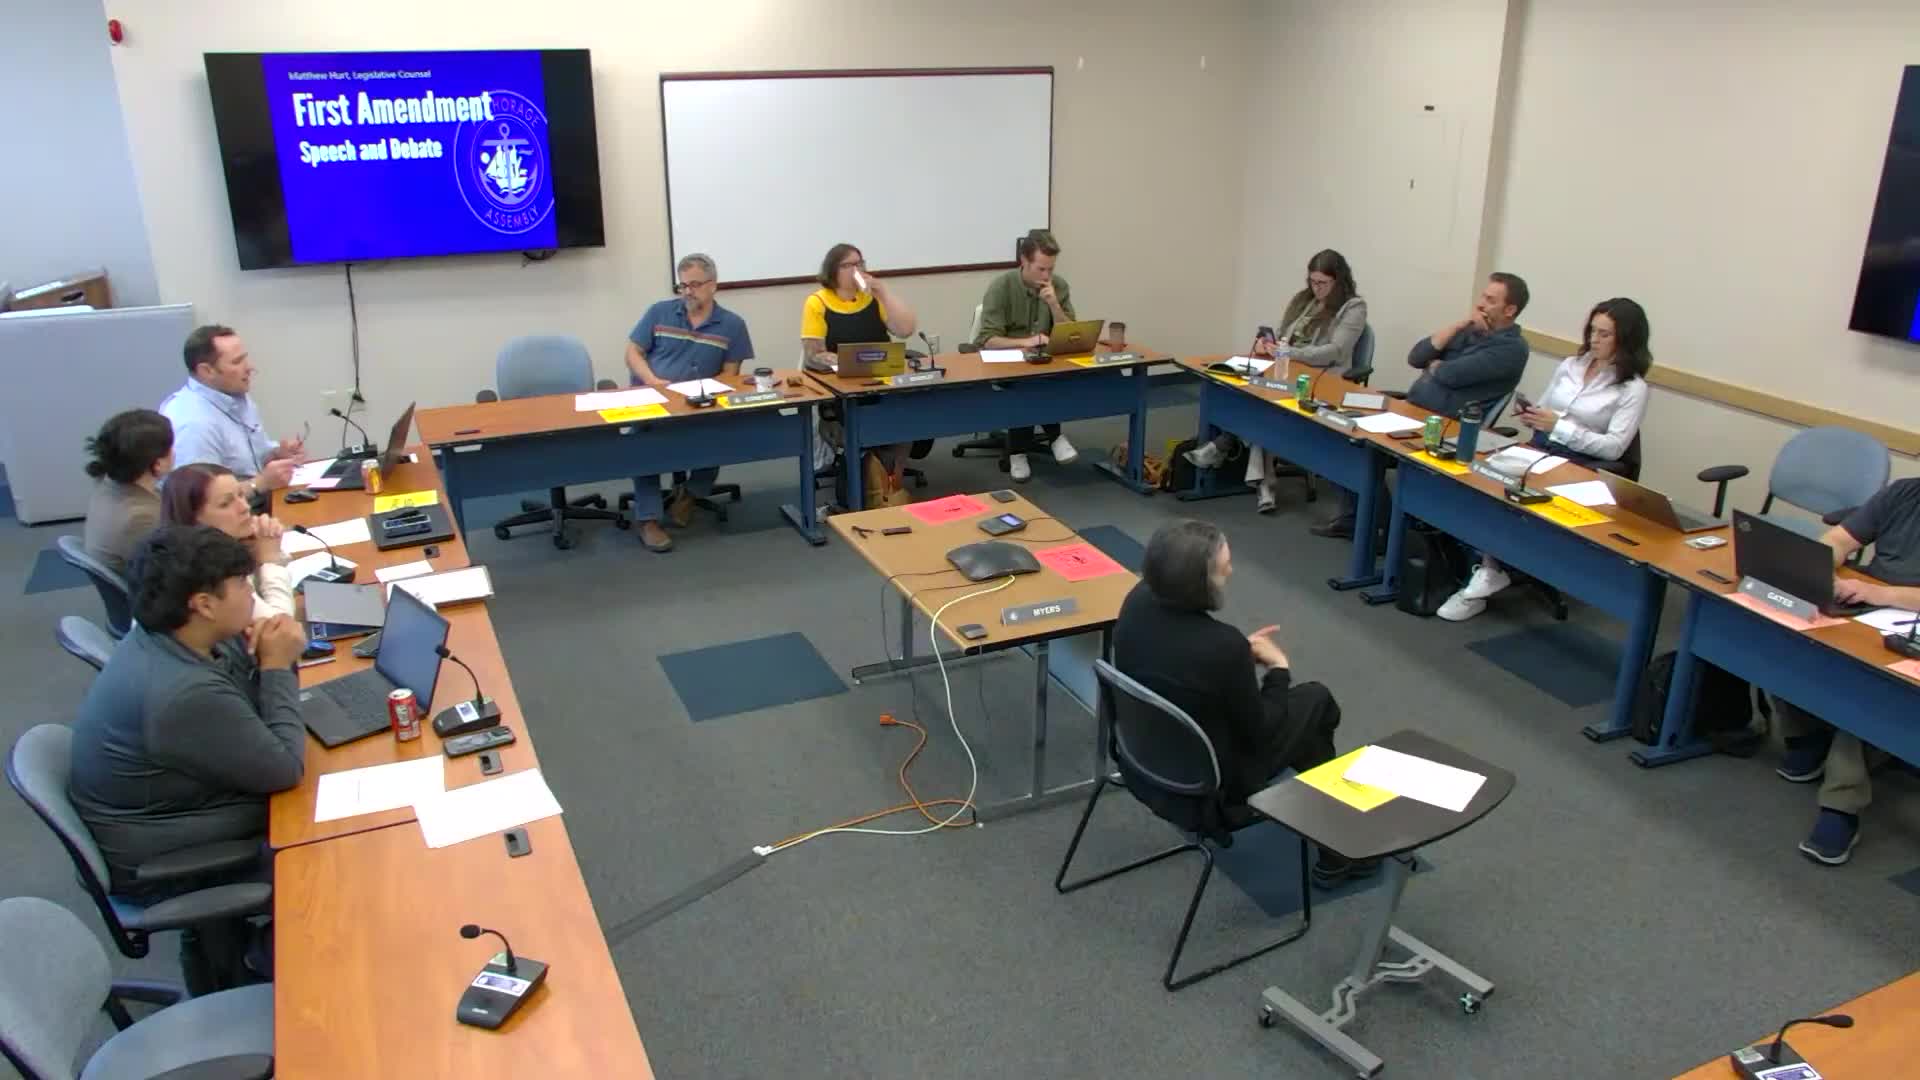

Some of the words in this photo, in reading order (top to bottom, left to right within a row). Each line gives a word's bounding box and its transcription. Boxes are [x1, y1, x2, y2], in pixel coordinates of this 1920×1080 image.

[352, 70, 396, 81] Legislative
[398, 70, 431, 79] Counsel
[292, 92, 352, 127] First
[358, 90, 494, 125] Amendment
[299, 139, 356, 168] Speech
[359, 138, 388, 160] and
[389, 137, 443, 160] Debate
[484, 204, 539, 228] ASSEMBLY
[1767, 591, 1793, 607] GATES
[1033, 604, 1061, 616] MYERS
